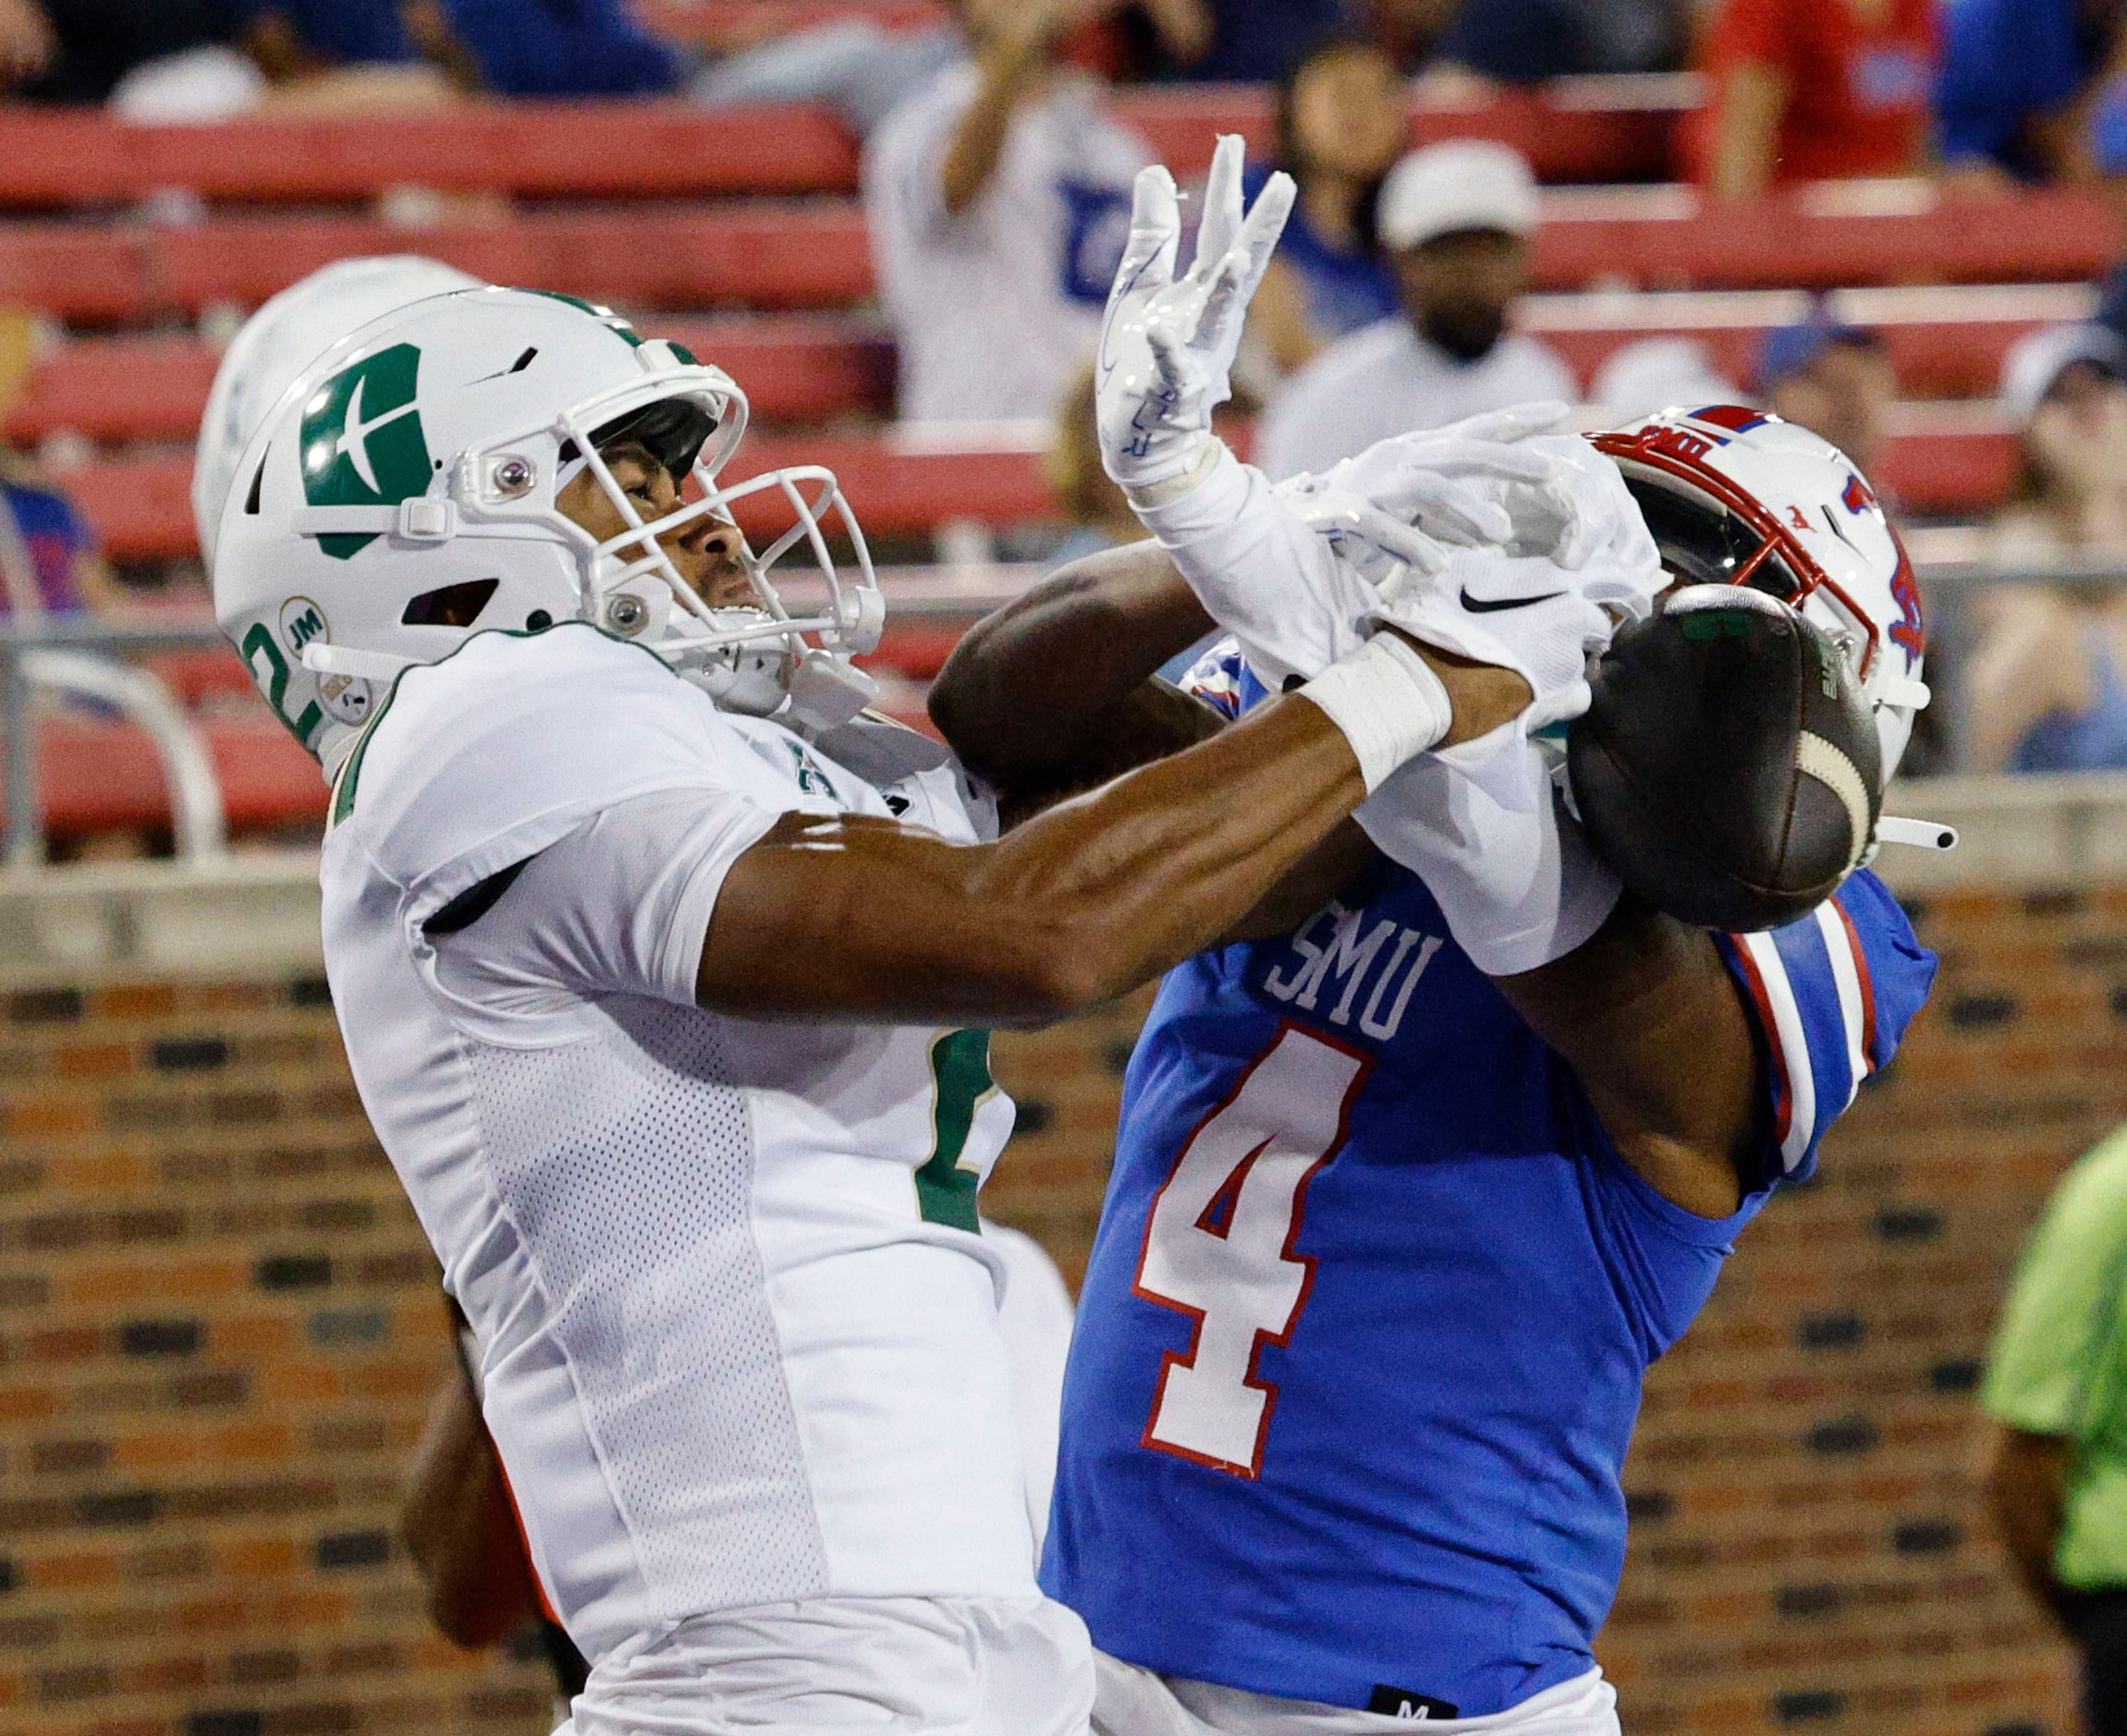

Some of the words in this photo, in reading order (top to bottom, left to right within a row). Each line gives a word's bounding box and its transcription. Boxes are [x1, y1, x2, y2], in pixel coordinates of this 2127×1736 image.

[288, 607, 324, 651] JM
[1263, 899, 1444, 1041] SMU
[1132, 1020, 1375, 1481] 4
